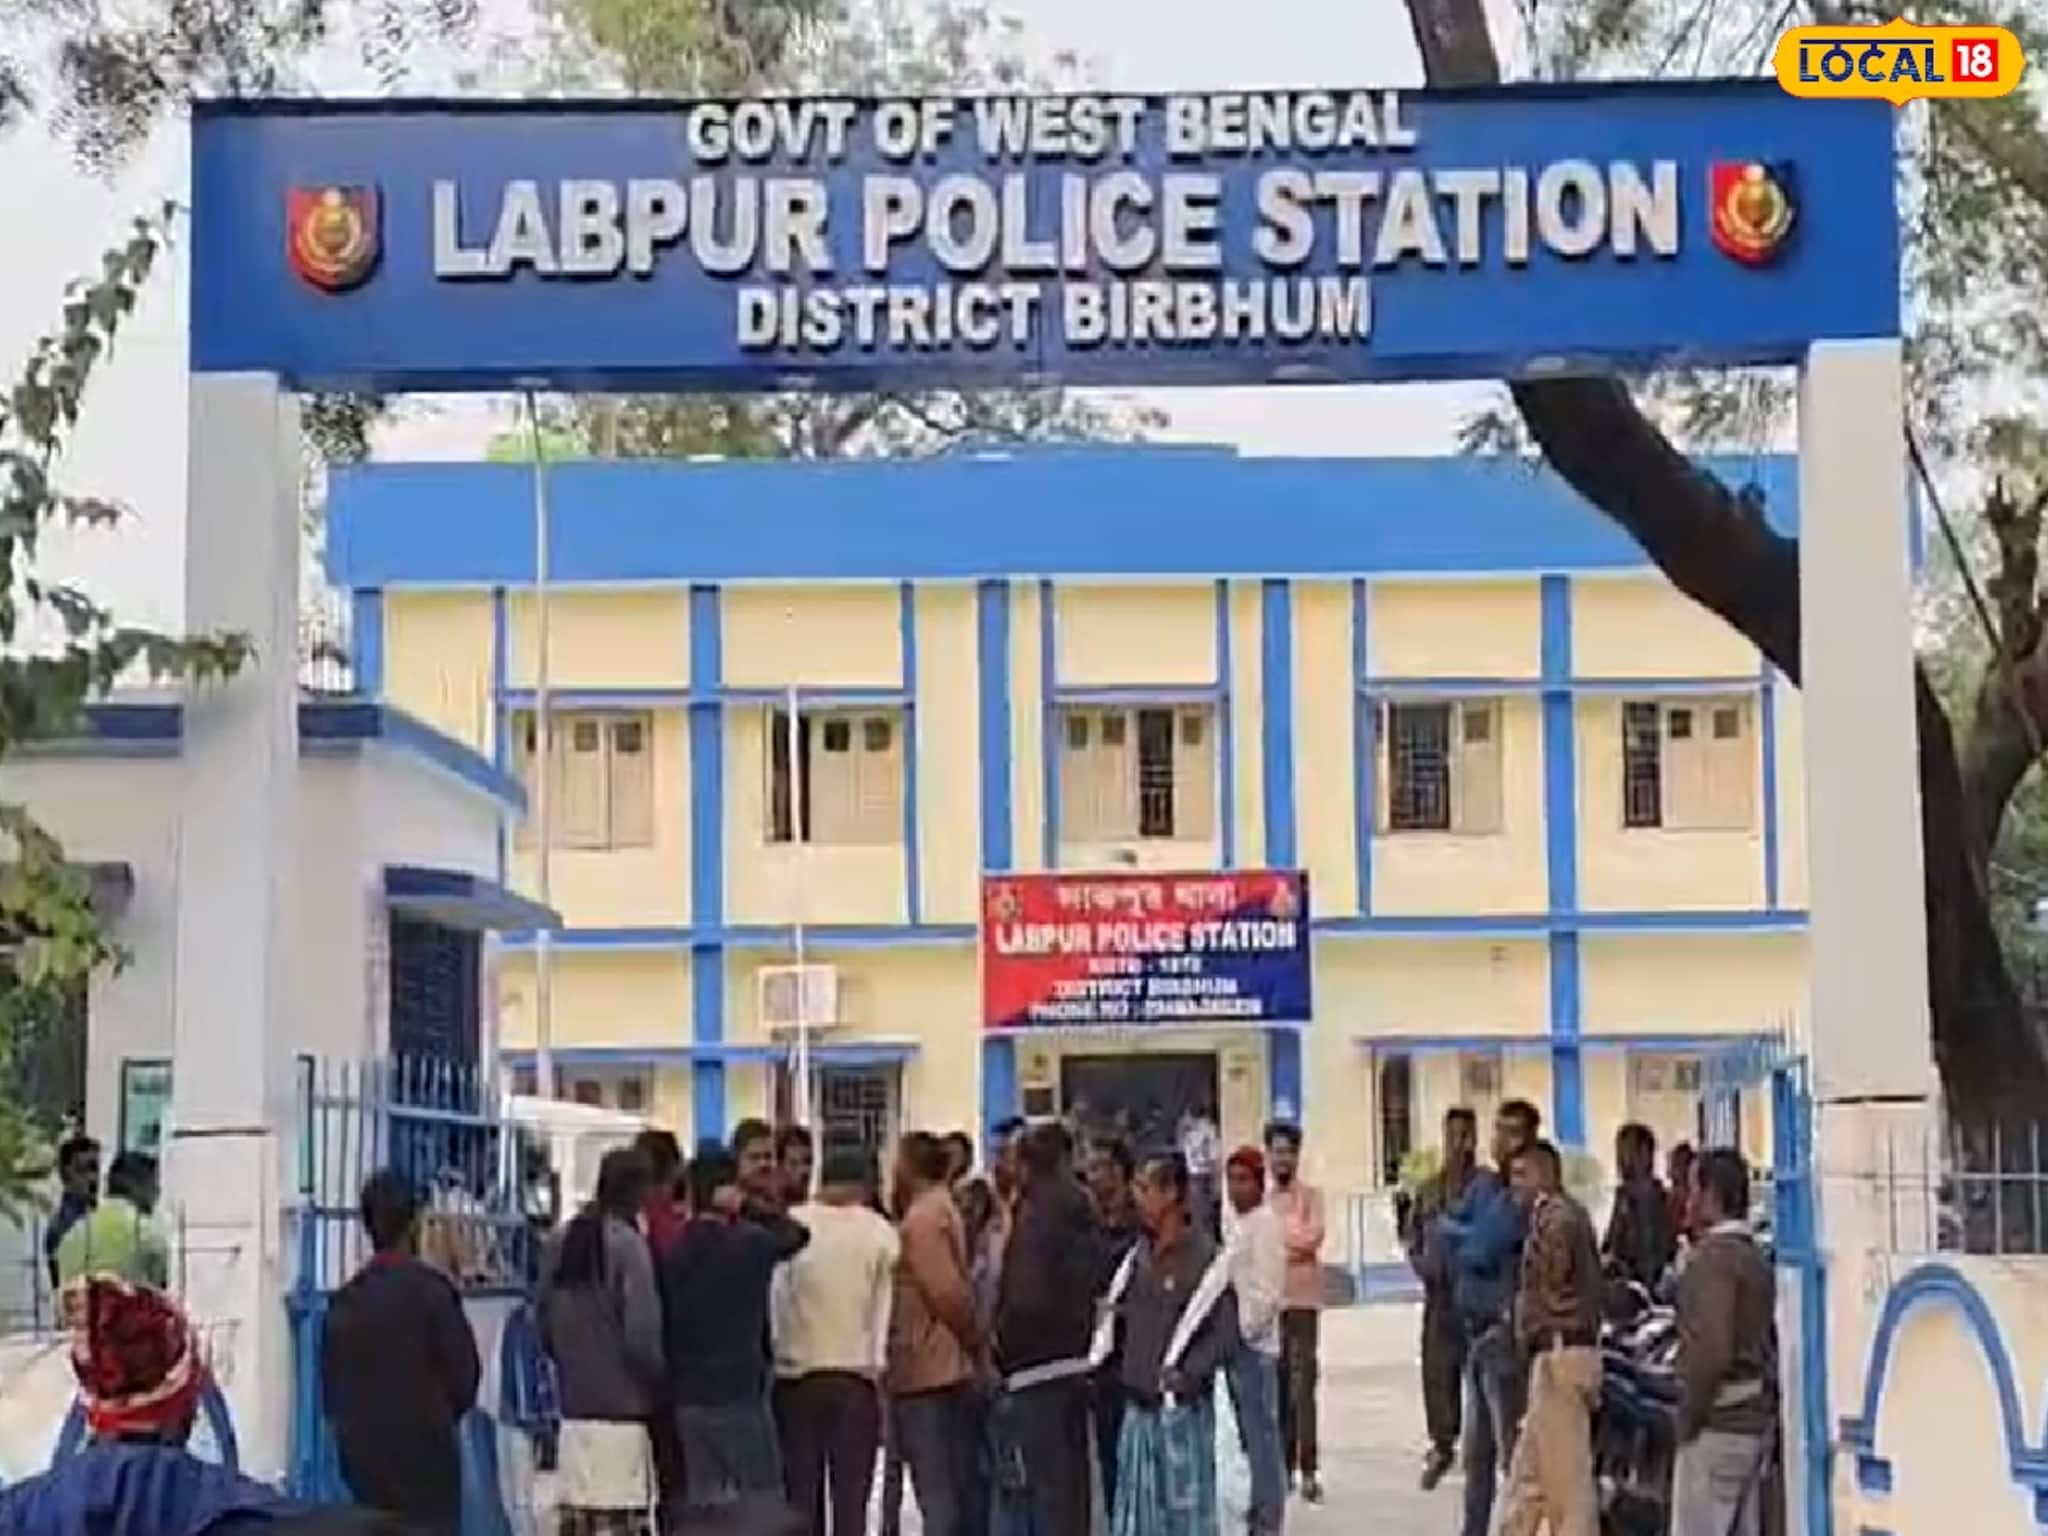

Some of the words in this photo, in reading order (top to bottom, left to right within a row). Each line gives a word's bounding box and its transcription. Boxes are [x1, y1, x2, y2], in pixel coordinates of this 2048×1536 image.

[686, 102, 853, 162] GOVT
[872, 102, 954, 160] OF
[977, 98, 1143, 158] WEST
[1164, 90, 1415, 152] BENGAL
[432, 176, 830, 277] LABPUR
[862, 168, 1222, 271] POLICE
[1254, 160, 1678, 266] STATION
[737, 282, 1040, 350] DISTRICT
[1062, 276, 1372, 344] BIRBHUM
[995, 922, 1092, 954] LABPUR
[1097, 924, 1186, 952] POLICE
[1189, 919, 1297, 948] STATION
